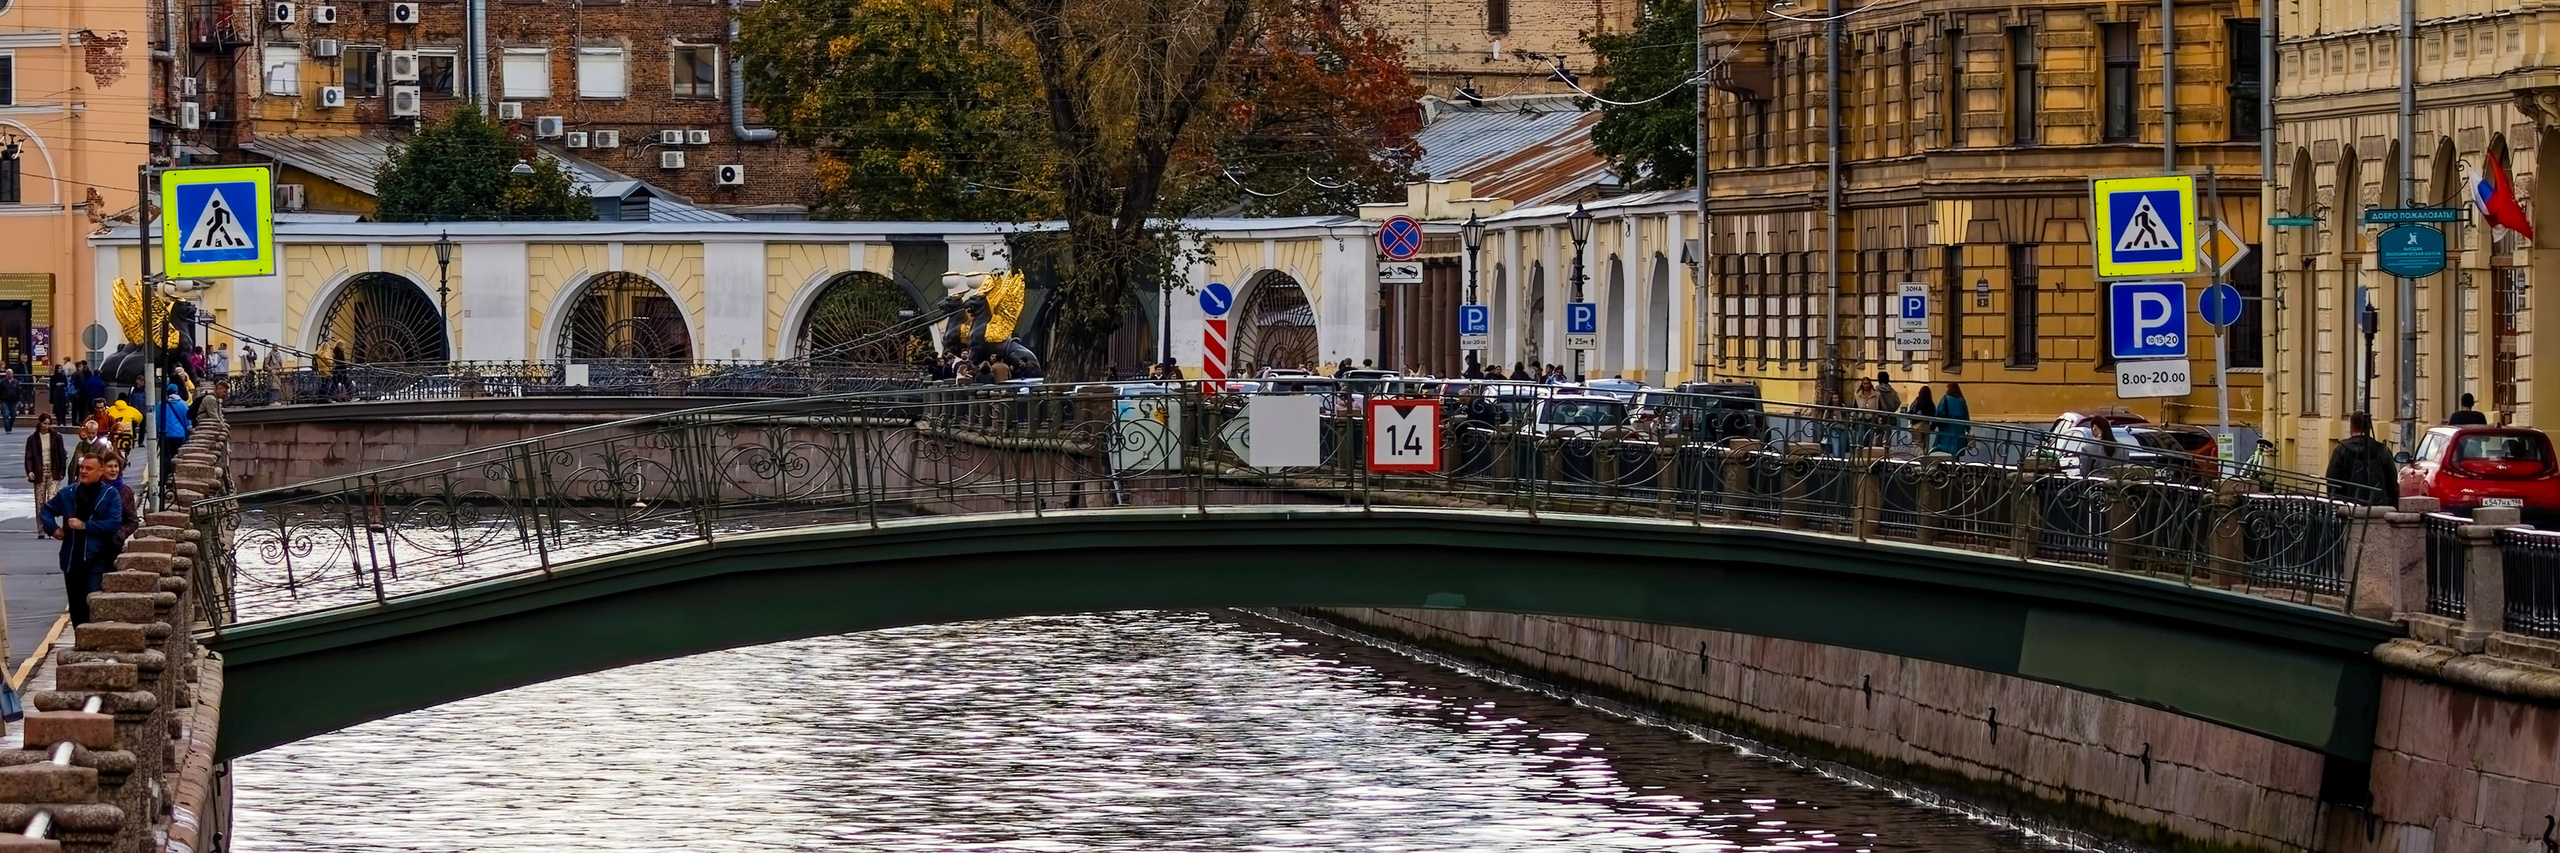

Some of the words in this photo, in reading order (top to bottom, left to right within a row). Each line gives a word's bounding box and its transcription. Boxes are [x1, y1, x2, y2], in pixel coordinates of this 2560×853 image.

[2400, 211, 2453, 219] ПОЖАЛОВАТЬ!
[1908, 298, 1921, 316] P
[1468, 308, 1483, 331] P
[1575, 306, 1591, 330] P
[2133, 292, 2172, 348] P
[2166, 335, 2178, 344] 20
[2122, 371, 2185, 385] 8.00-20.00
[1386, 424, 1422, 456] 1.4
